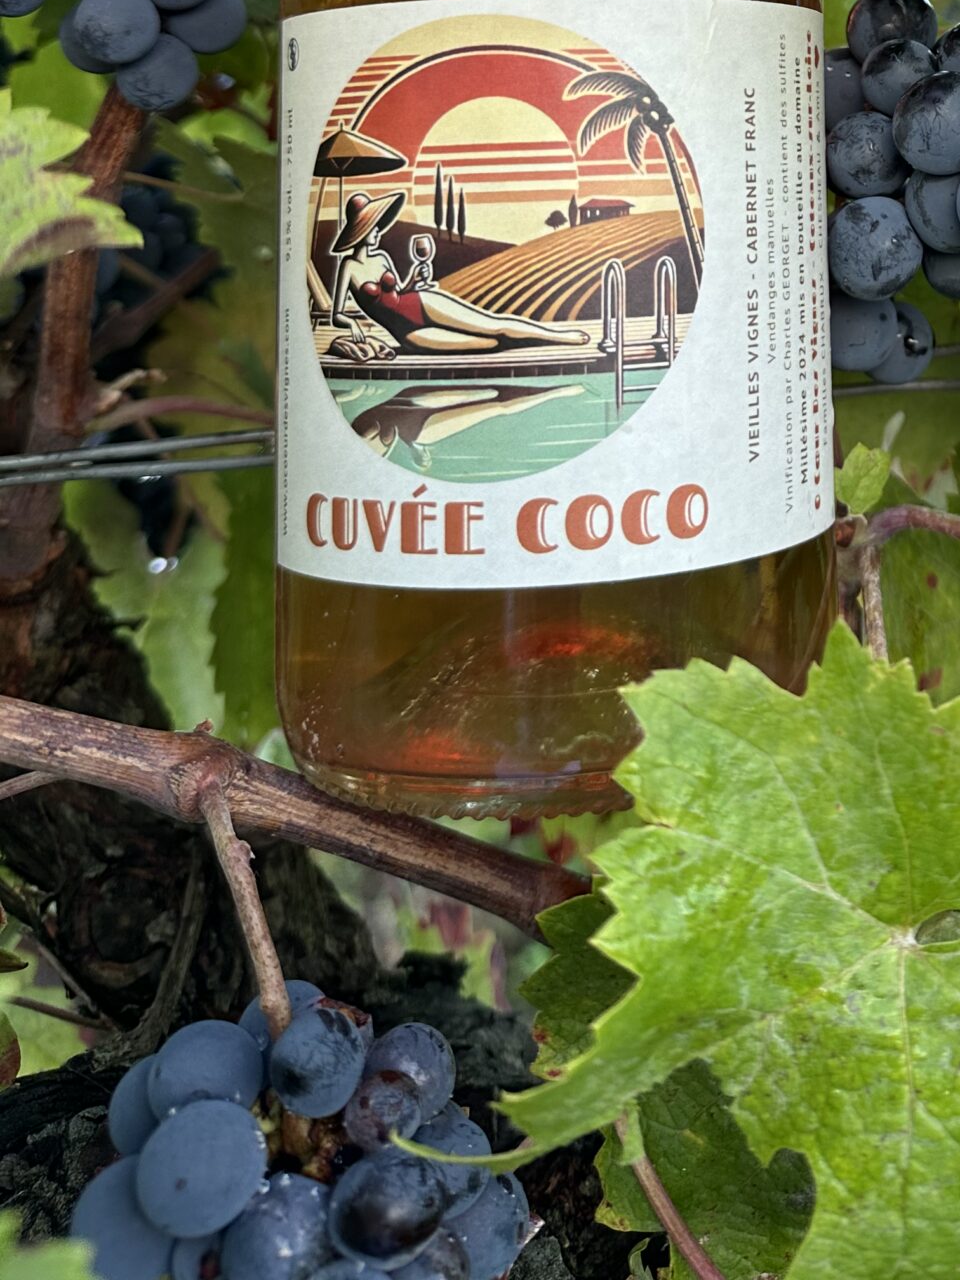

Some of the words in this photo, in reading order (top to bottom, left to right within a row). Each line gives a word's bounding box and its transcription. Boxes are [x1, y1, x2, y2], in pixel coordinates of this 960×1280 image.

[777, 34, 787, 94] sulfites
[793, 57, 802, 135] domaine
[743, 88, 756, 152] FRANC
[778, 101, 788, 128] des
[779, 136, 789, 203] contient
[796, 142, 803, 163] au
[745, 160, 758, 265] CABERNET
[765, 178, 775, 264] manuelles
[795, 171, 805, 256] bouteille
[781, 224, 791, 301] GEORGET
[798, 263, 805, 286] en
[747, 289, 759, 364] VIGNES
[767, 272, 778, 365] Vendanges
[782, 309, 792, 370] Charles
[797, 293, 806, 325] mis
[785, 379, 794, 404] par
[798, 334, 806, 381] 2024
[748, 372, 760, 463] VIEILLES
[799, 390, 809, 484] Millésime
[784, 412, 794, 513] Vinification
[306, 483, 485, 555] CUVÉE
[516, 483, 709, 555] COCO
